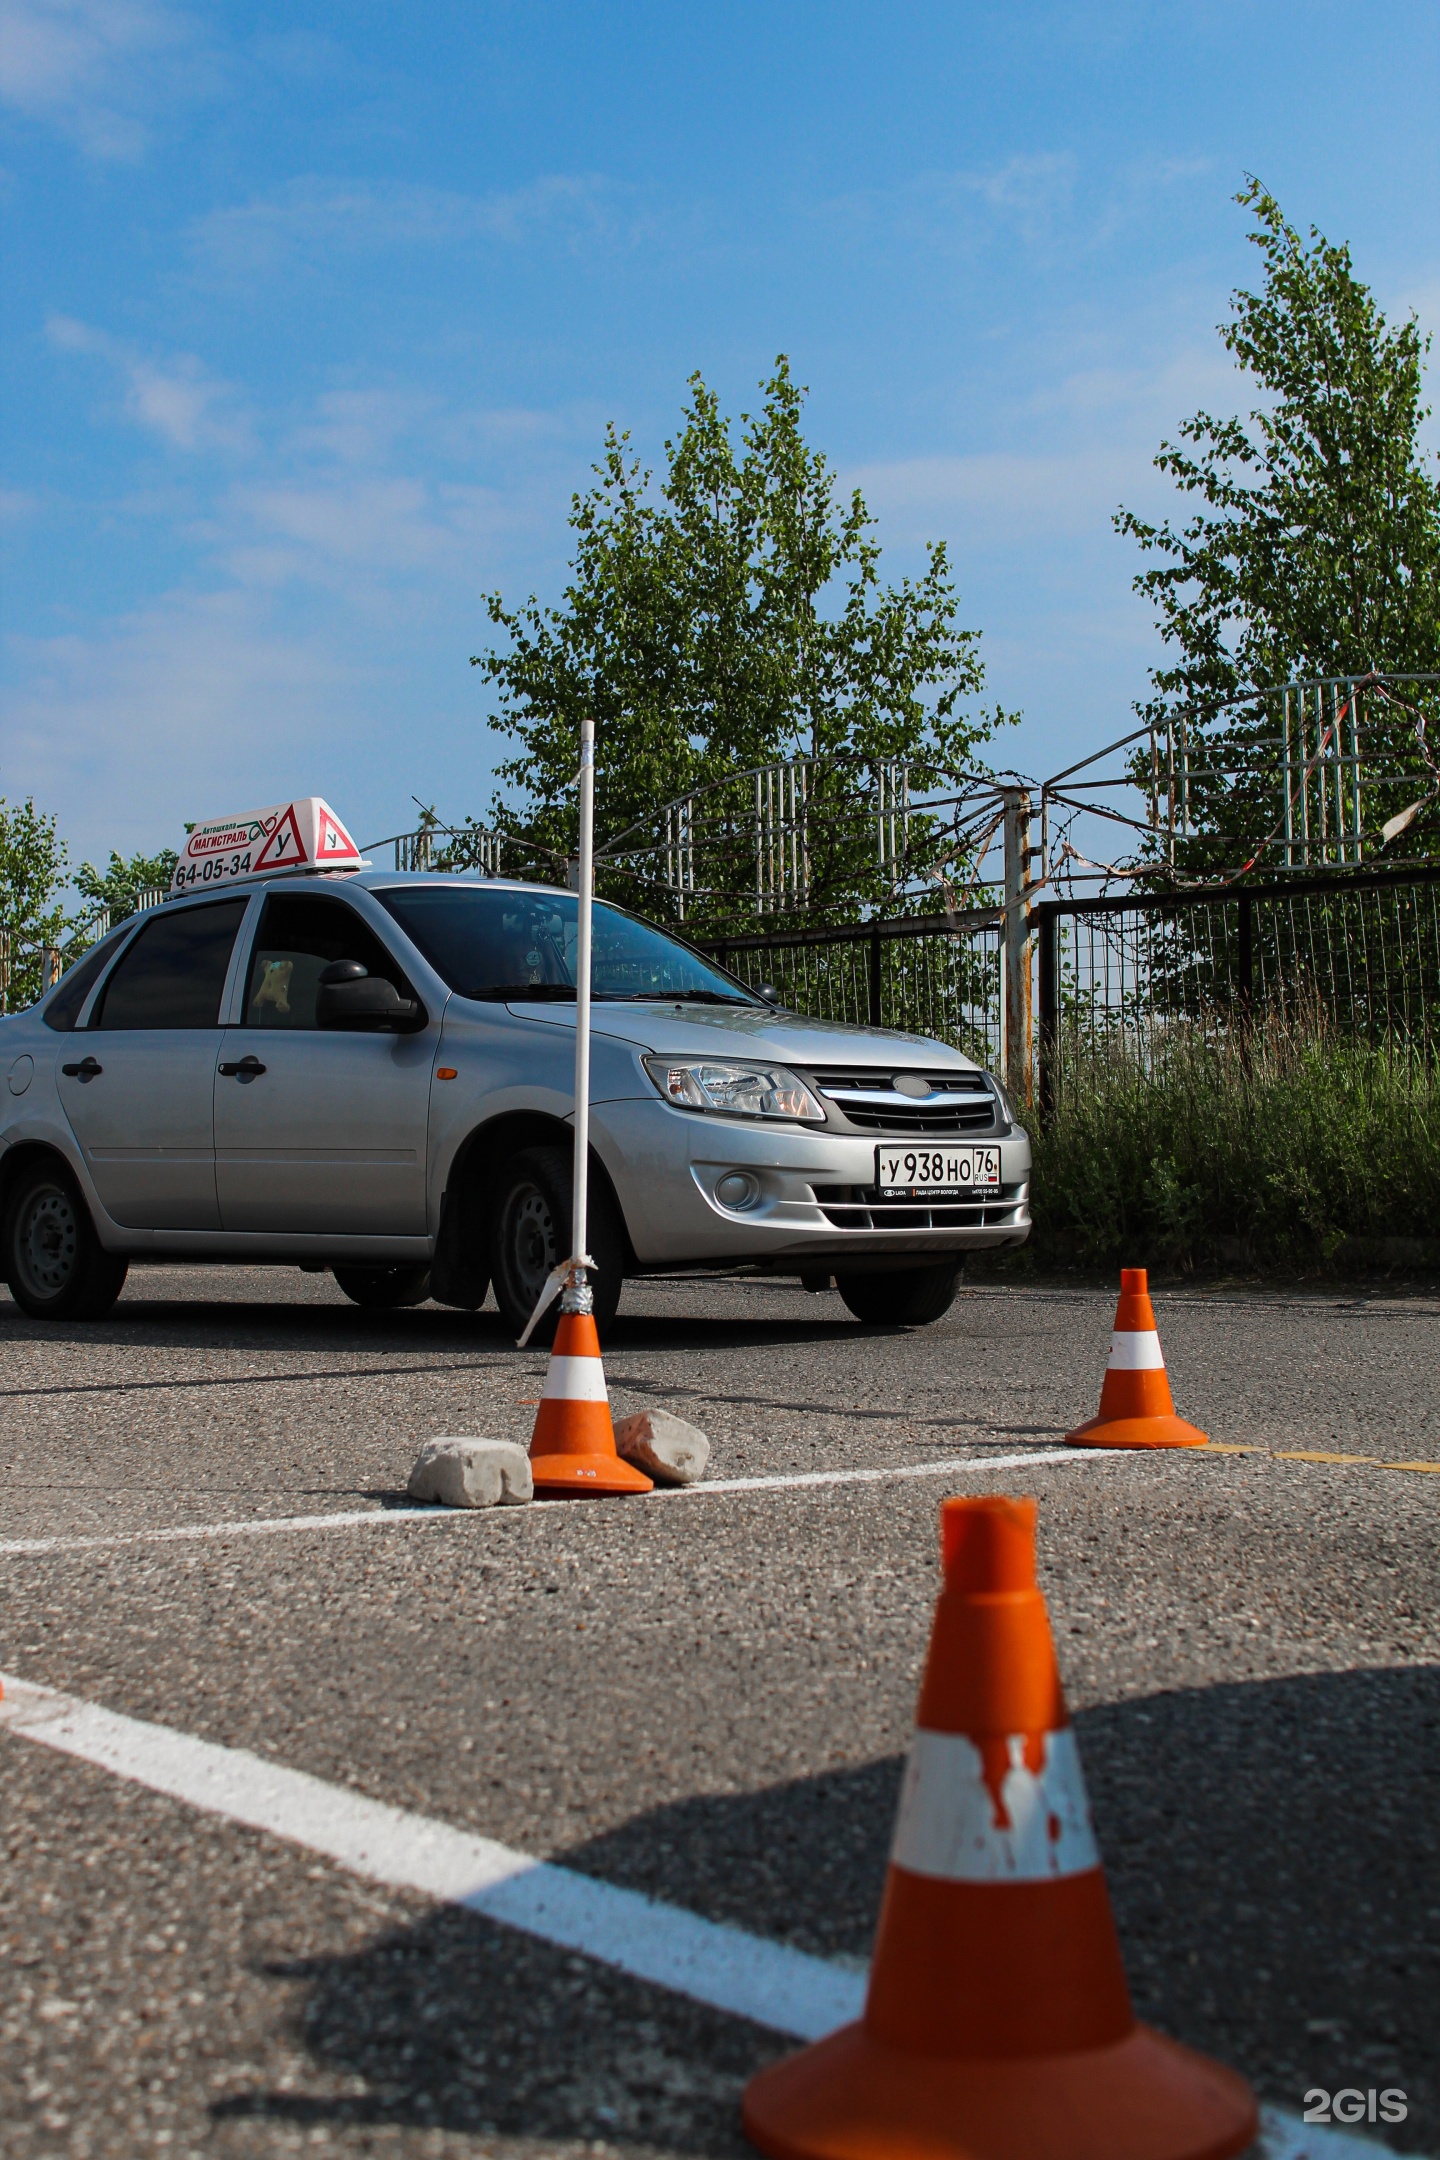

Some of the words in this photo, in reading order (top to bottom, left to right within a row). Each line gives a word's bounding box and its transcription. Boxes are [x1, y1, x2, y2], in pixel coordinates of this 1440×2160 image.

[202, 822, 237, 835] Автошкола
[193, 830, 248, 850] МАГИСТРАЛЬ
[275, 832, 292, 858] У
[327, 833, 337, 848] У
[175, 852, 252, 887] 64-05-34
[976, 1151, 994, 1173] 76
[975, 1173, 988, 1181] RUS
